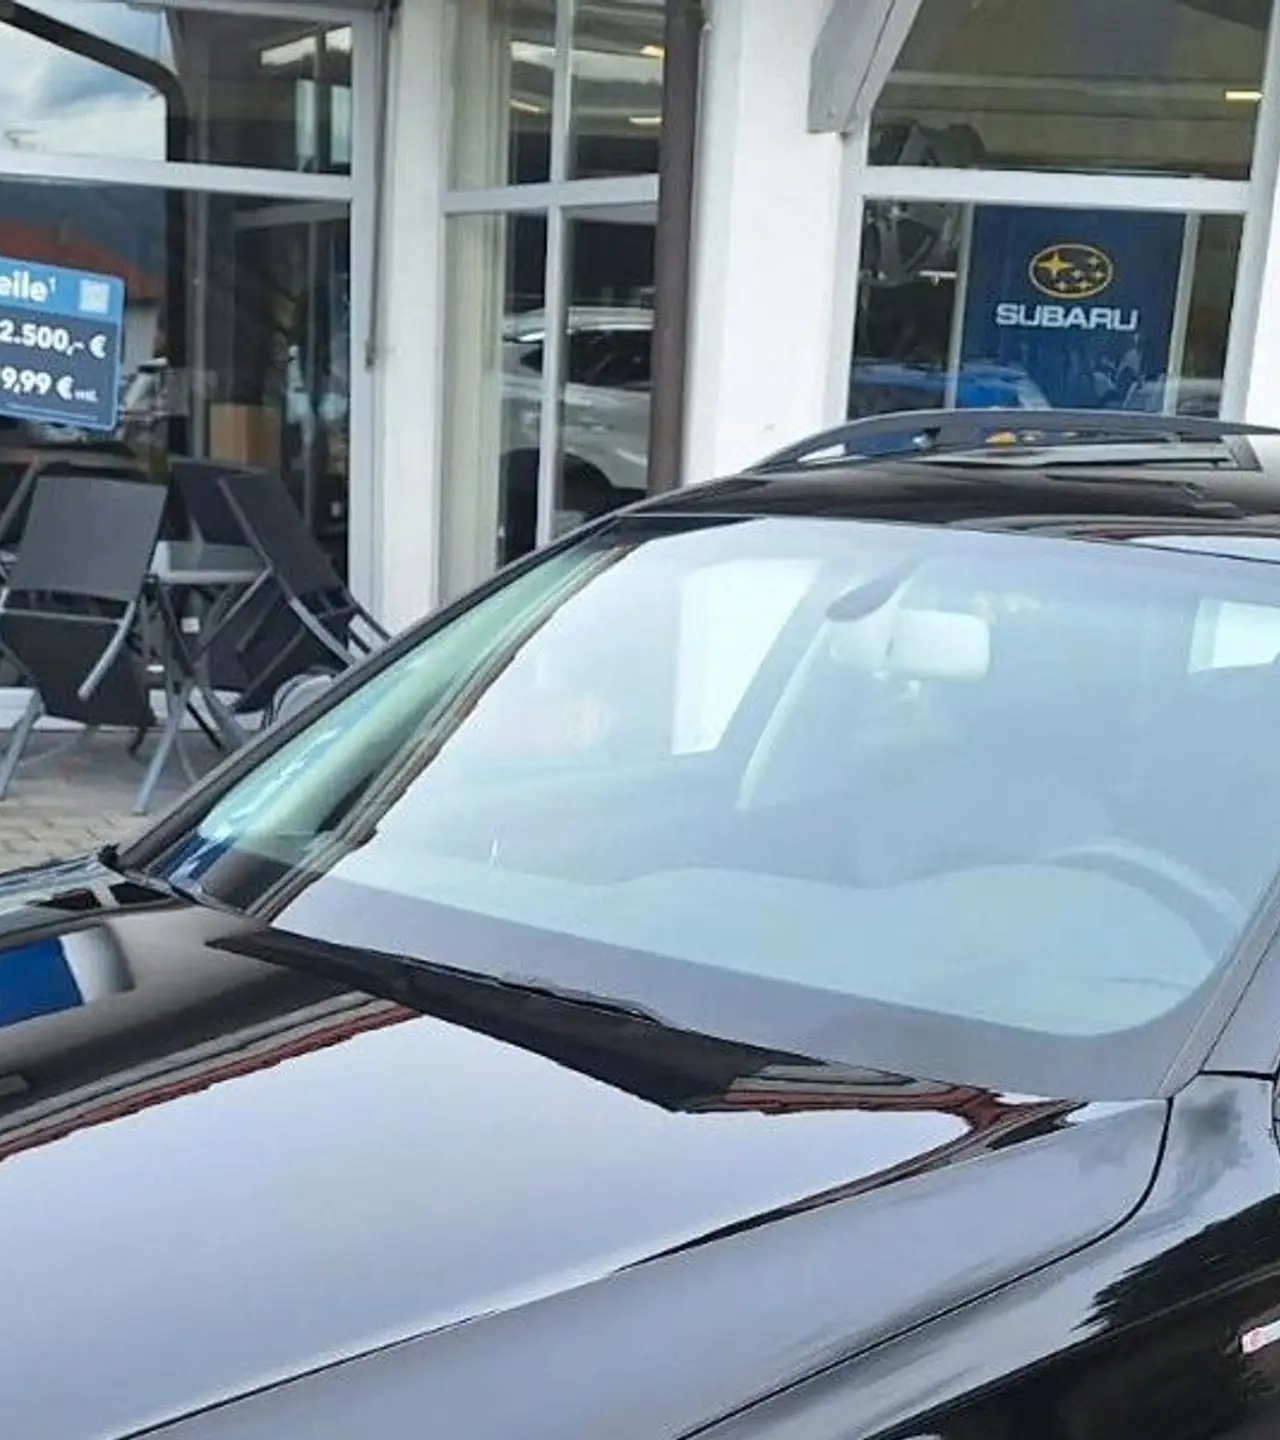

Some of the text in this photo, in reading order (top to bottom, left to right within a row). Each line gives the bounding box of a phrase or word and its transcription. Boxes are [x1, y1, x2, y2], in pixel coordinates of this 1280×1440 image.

[995, 303, 1139, 331] SUBARU
[89, 334, 107, 359] €
[56, 375, 74, 400] €
